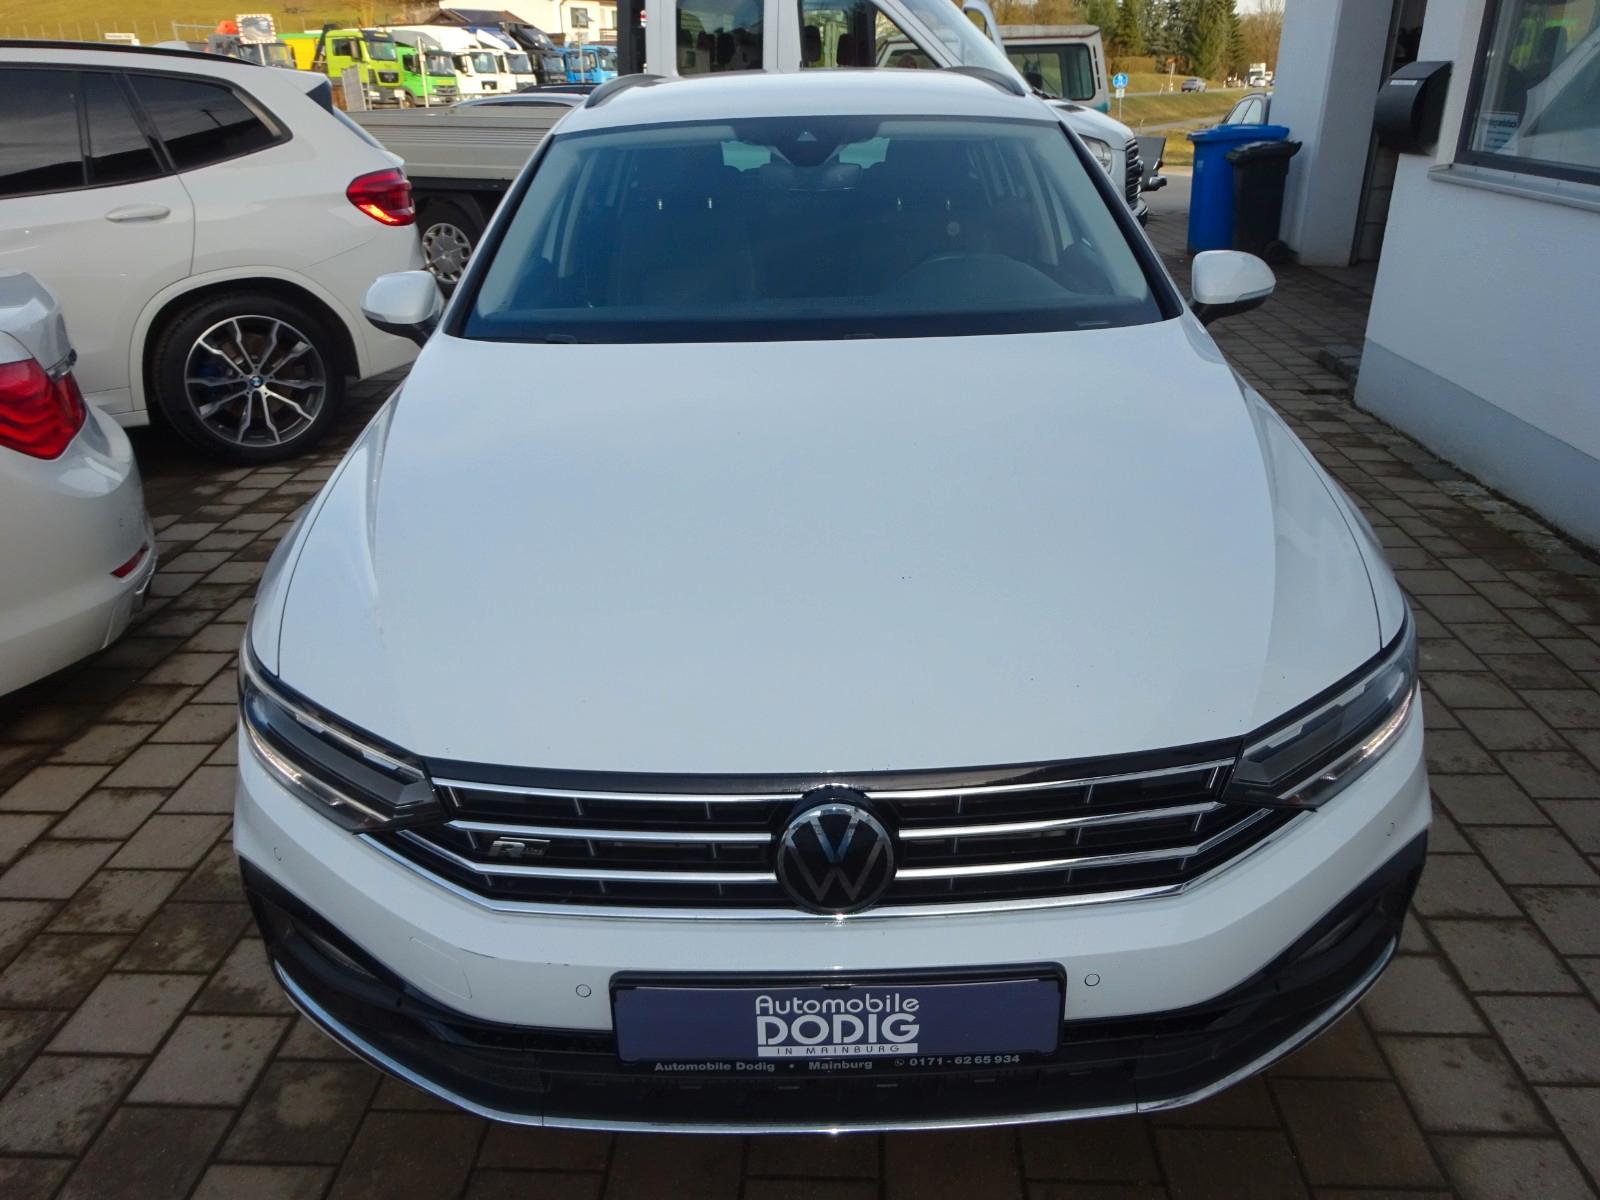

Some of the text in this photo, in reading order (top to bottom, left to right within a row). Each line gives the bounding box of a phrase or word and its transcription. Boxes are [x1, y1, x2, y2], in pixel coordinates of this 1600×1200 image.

[778, 804, 893, 911] VW
[755, 993, 920, 1015] Automobile
[756, 1012, 920, 1046] DODIG
[776, 1045, 900, 1056] IN MAINBURG
[654, 1061, 732, 1072] Automobile
[735, 1061, 776, 1073] Dodig
[808, 1060, 874, 1071] Mainburg
